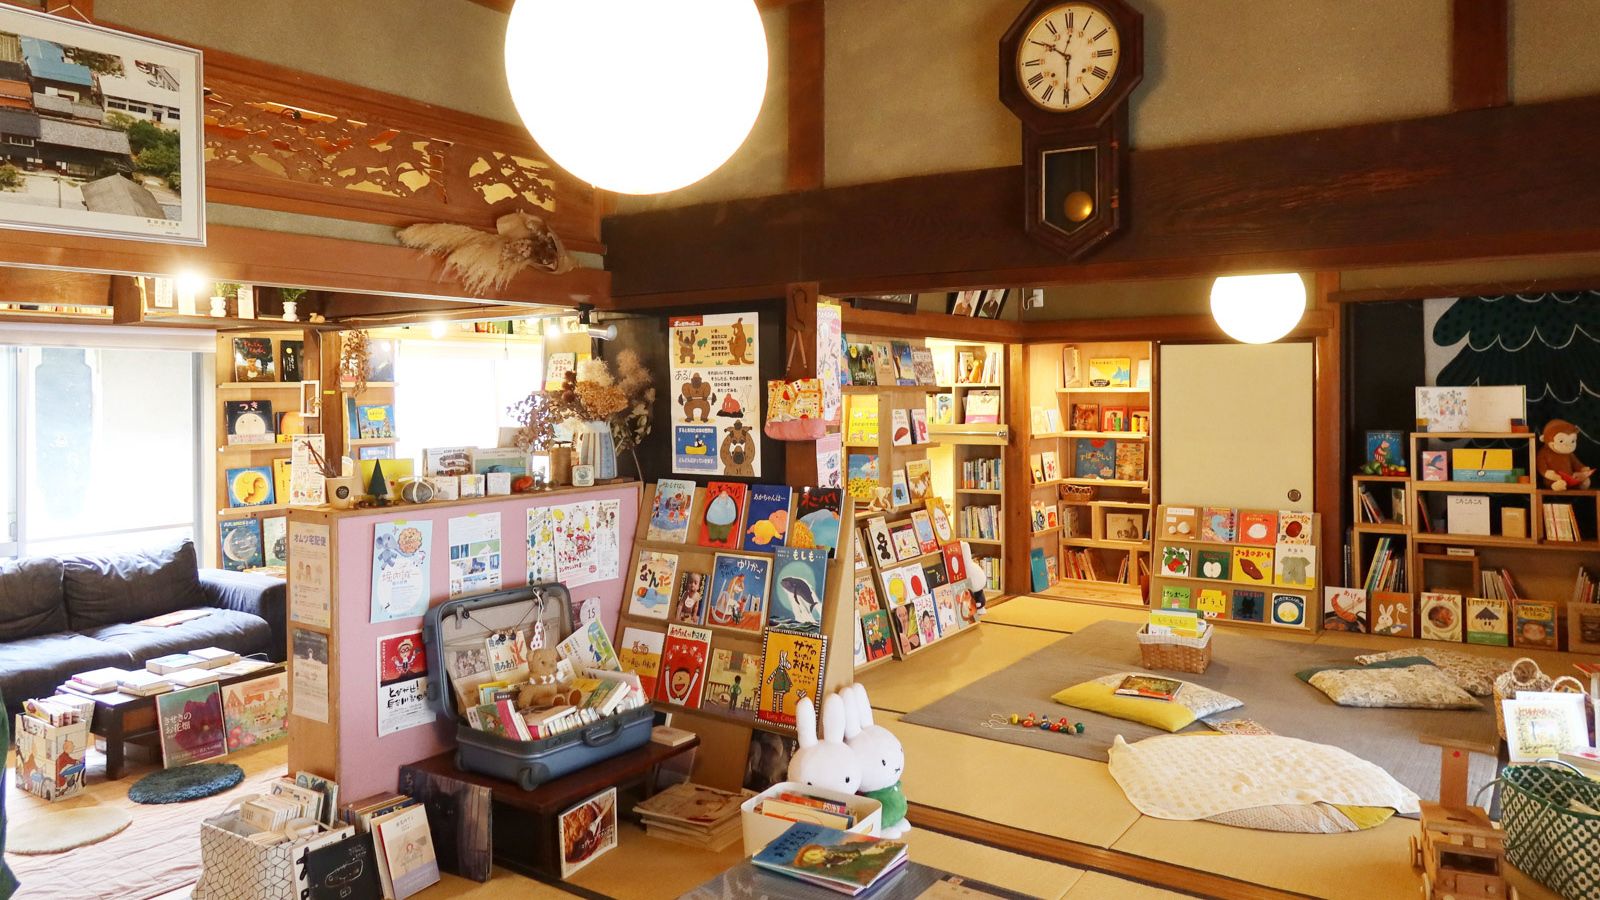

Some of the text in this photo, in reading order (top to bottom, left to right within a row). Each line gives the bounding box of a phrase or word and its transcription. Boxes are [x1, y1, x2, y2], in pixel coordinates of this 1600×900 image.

[293, 533, 327, 547] オムツ宅配便
